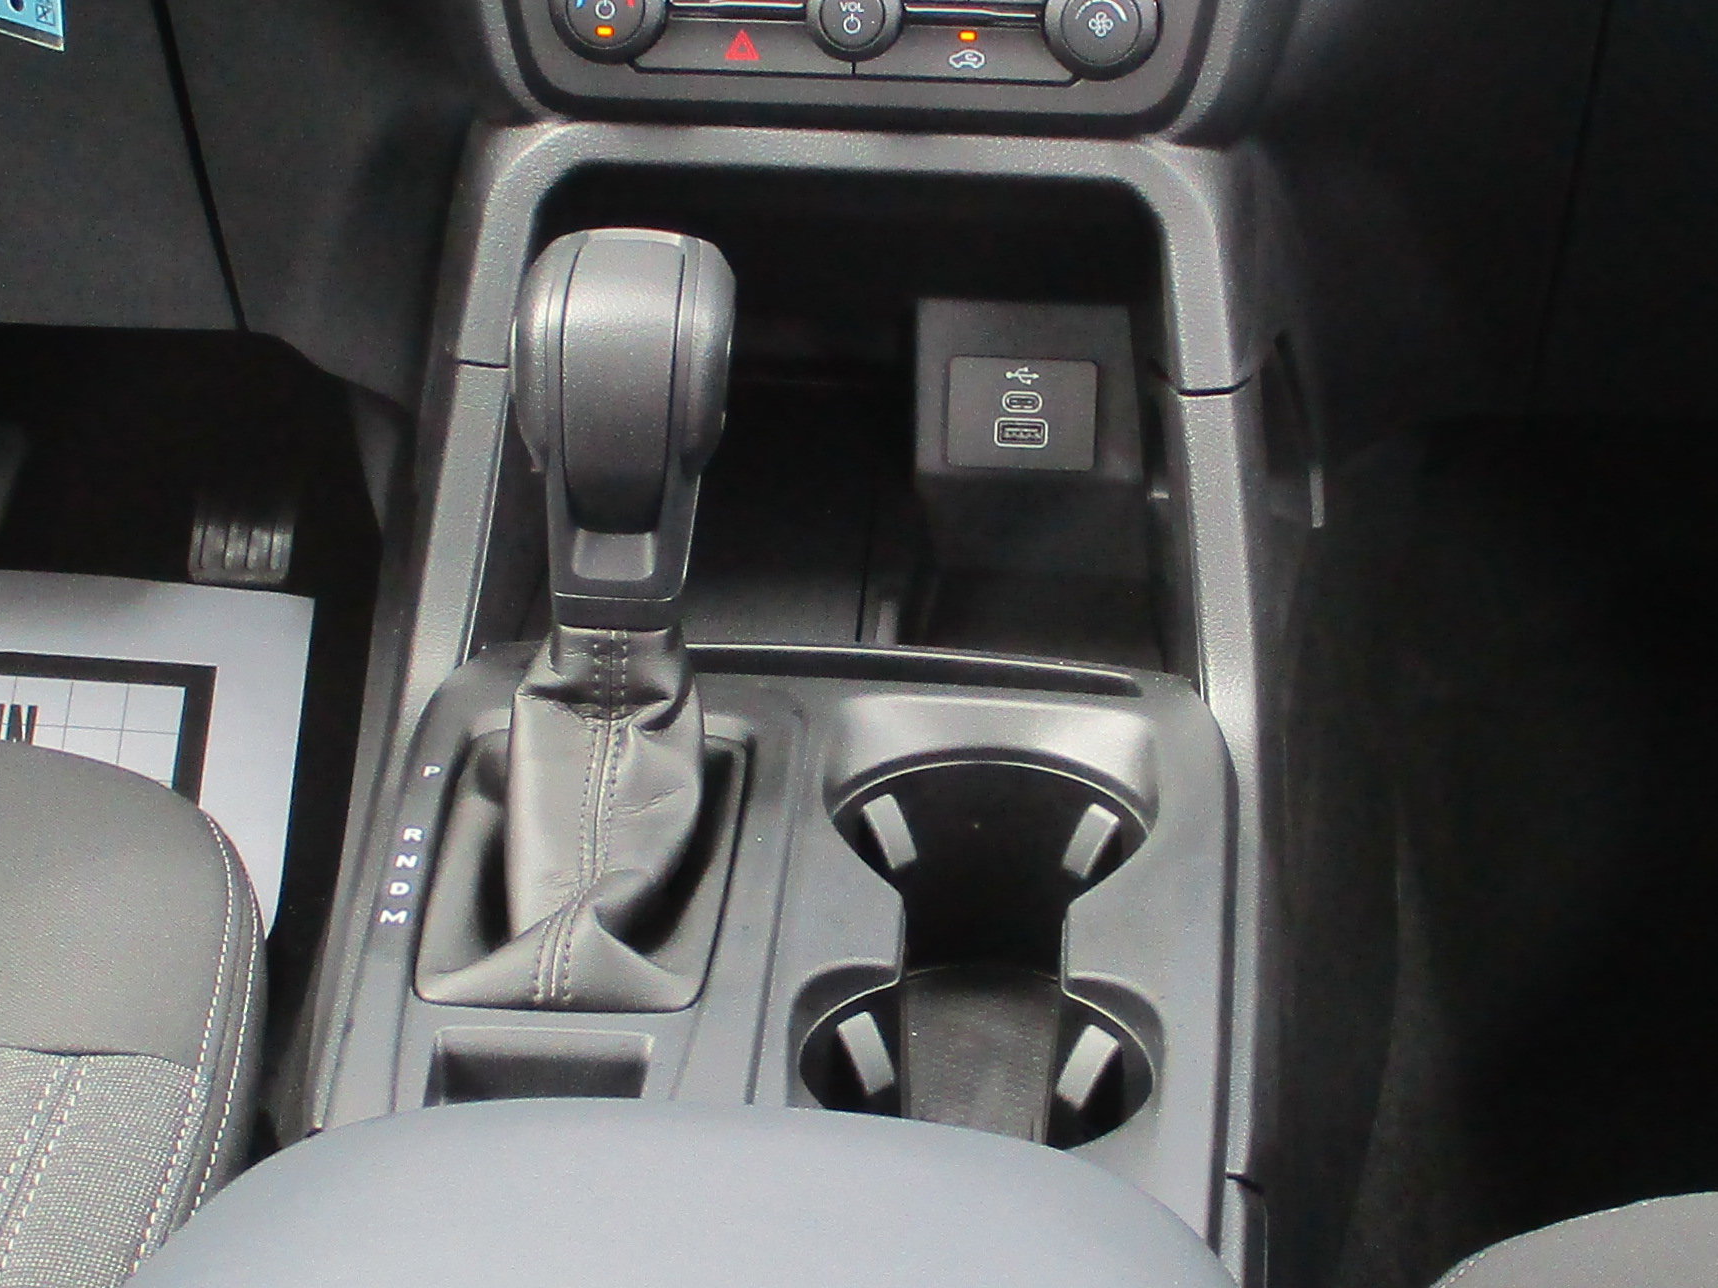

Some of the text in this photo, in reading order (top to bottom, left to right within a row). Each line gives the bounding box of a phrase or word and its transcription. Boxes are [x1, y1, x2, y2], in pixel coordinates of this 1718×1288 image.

[839, 1, 865, 13] VOL
[423, 766, 440, 777] P
[403, 828, 423, 841] R
[396, 855, 418, 868] N
[389, 882, 411, 895] D
[380, 910, 407, 924] M
